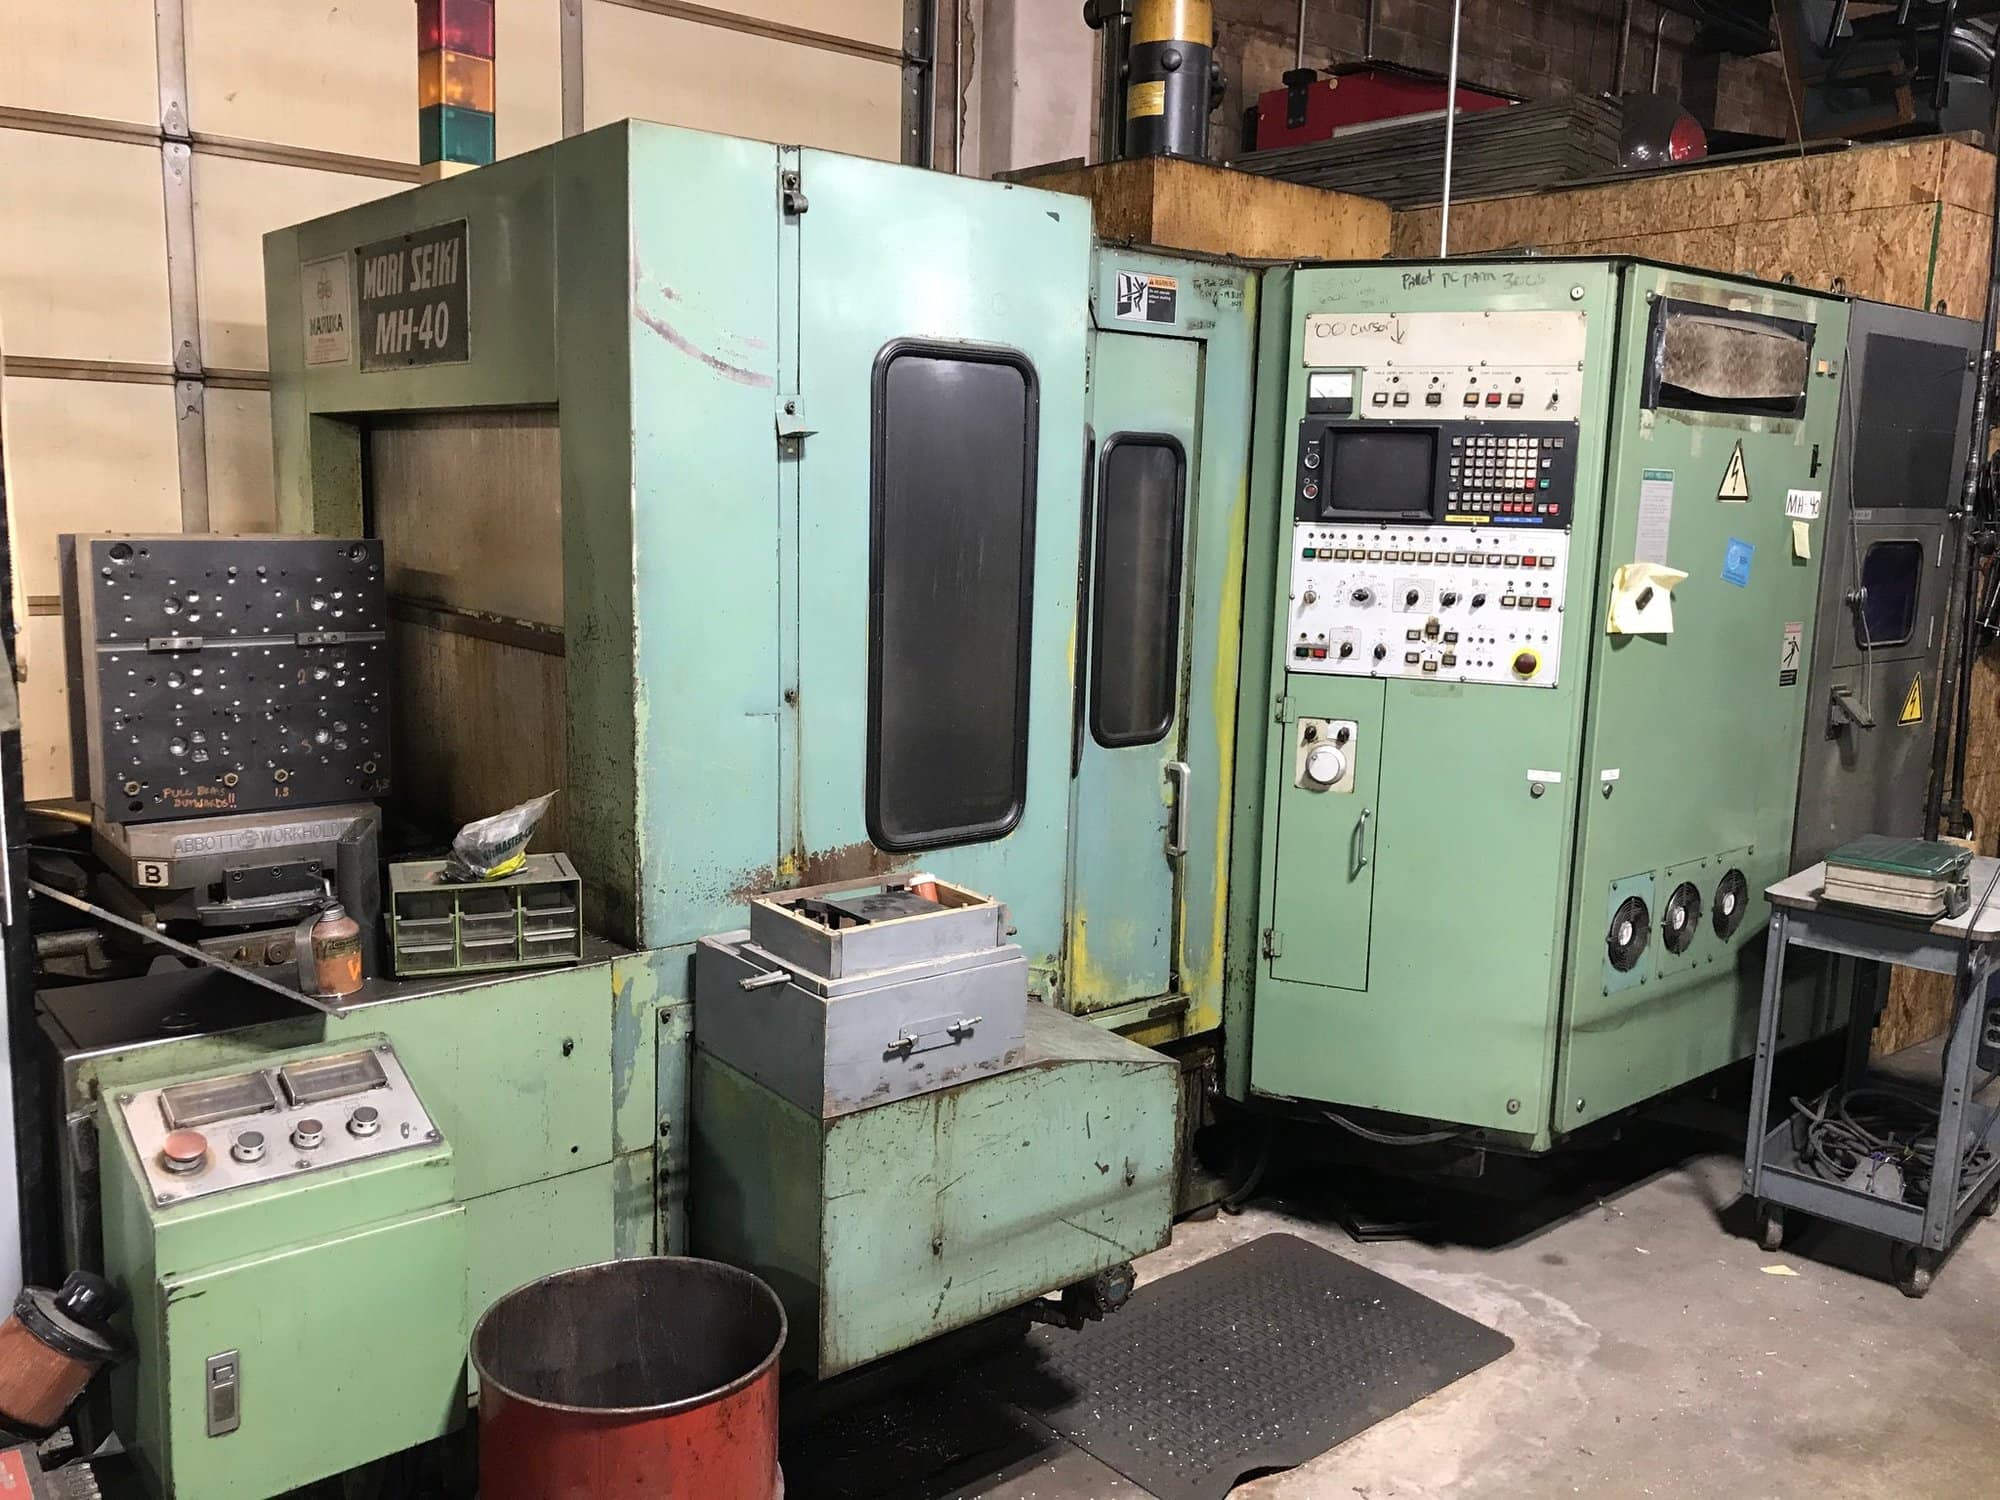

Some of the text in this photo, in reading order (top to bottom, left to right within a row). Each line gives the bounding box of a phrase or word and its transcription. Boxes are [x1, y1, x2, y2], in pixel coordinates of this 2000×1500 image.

[363, 237, 460, 300] MORI SEIKI
[375, 301, 450, 355] MH-40
[174, 832, 235, 853] ABBOTT
[144, 865, 161, 884] B
